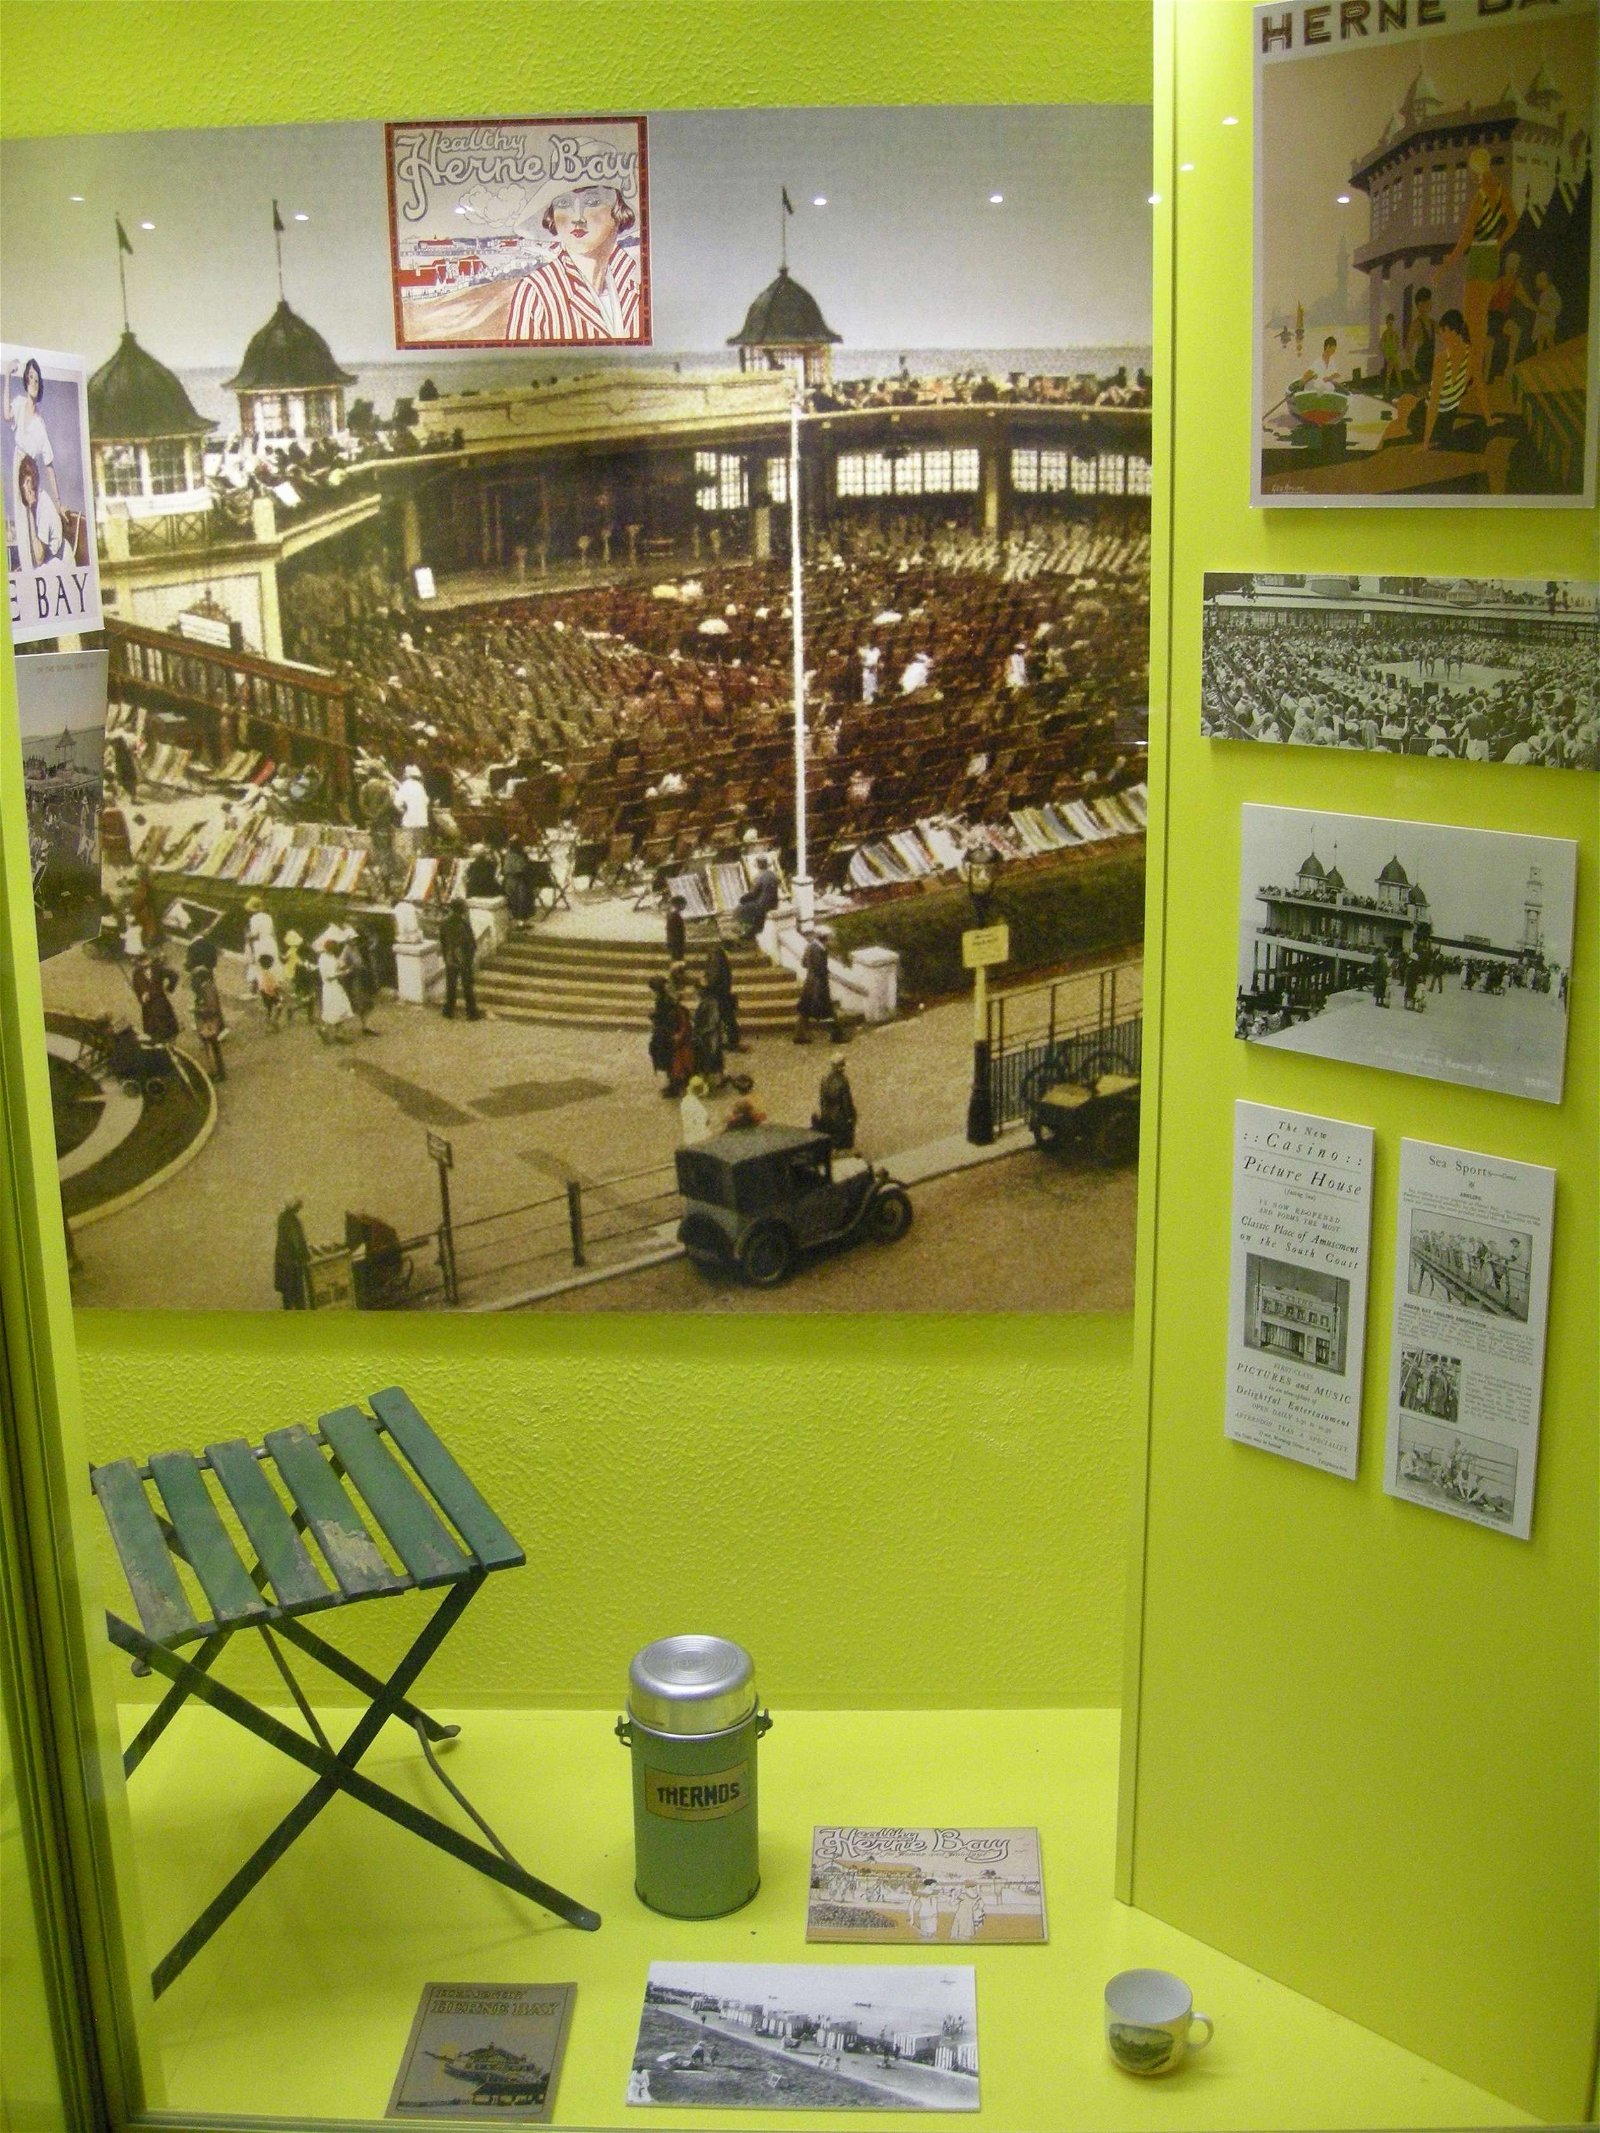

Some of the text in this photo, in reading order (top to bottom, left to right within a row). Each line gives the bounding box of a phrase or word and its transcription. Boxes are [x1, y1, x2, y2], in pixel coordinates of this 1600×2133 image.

[1262, 0, 1446, 54] HERNE
[397, 132, 639, 221] Herne Bay
[35, 573, 88, 618] BAY
[1266, 1132, 1339, 1161] Casino
[1278, 1121, 1327, 1139] The New
[1243, 1155, 1362, 1196] Picture House
[1429, 1155, 1447, 1168] Sea
[1240, 1233, 1359, 1269] on the South Coast
[1241, 1215, 1360, 1254] Classic Place of Amusement
[1236, 1362, 1352, 1405] PICTURES and MUSIC
[1236, 1385, 1281, 1405] Delightful
[1288, 1401, 1350, 1427] Entertainment
[656, 1782, 741, 1808] THERMOS
[815, 1828, 1011, 1863] Herne Bay
